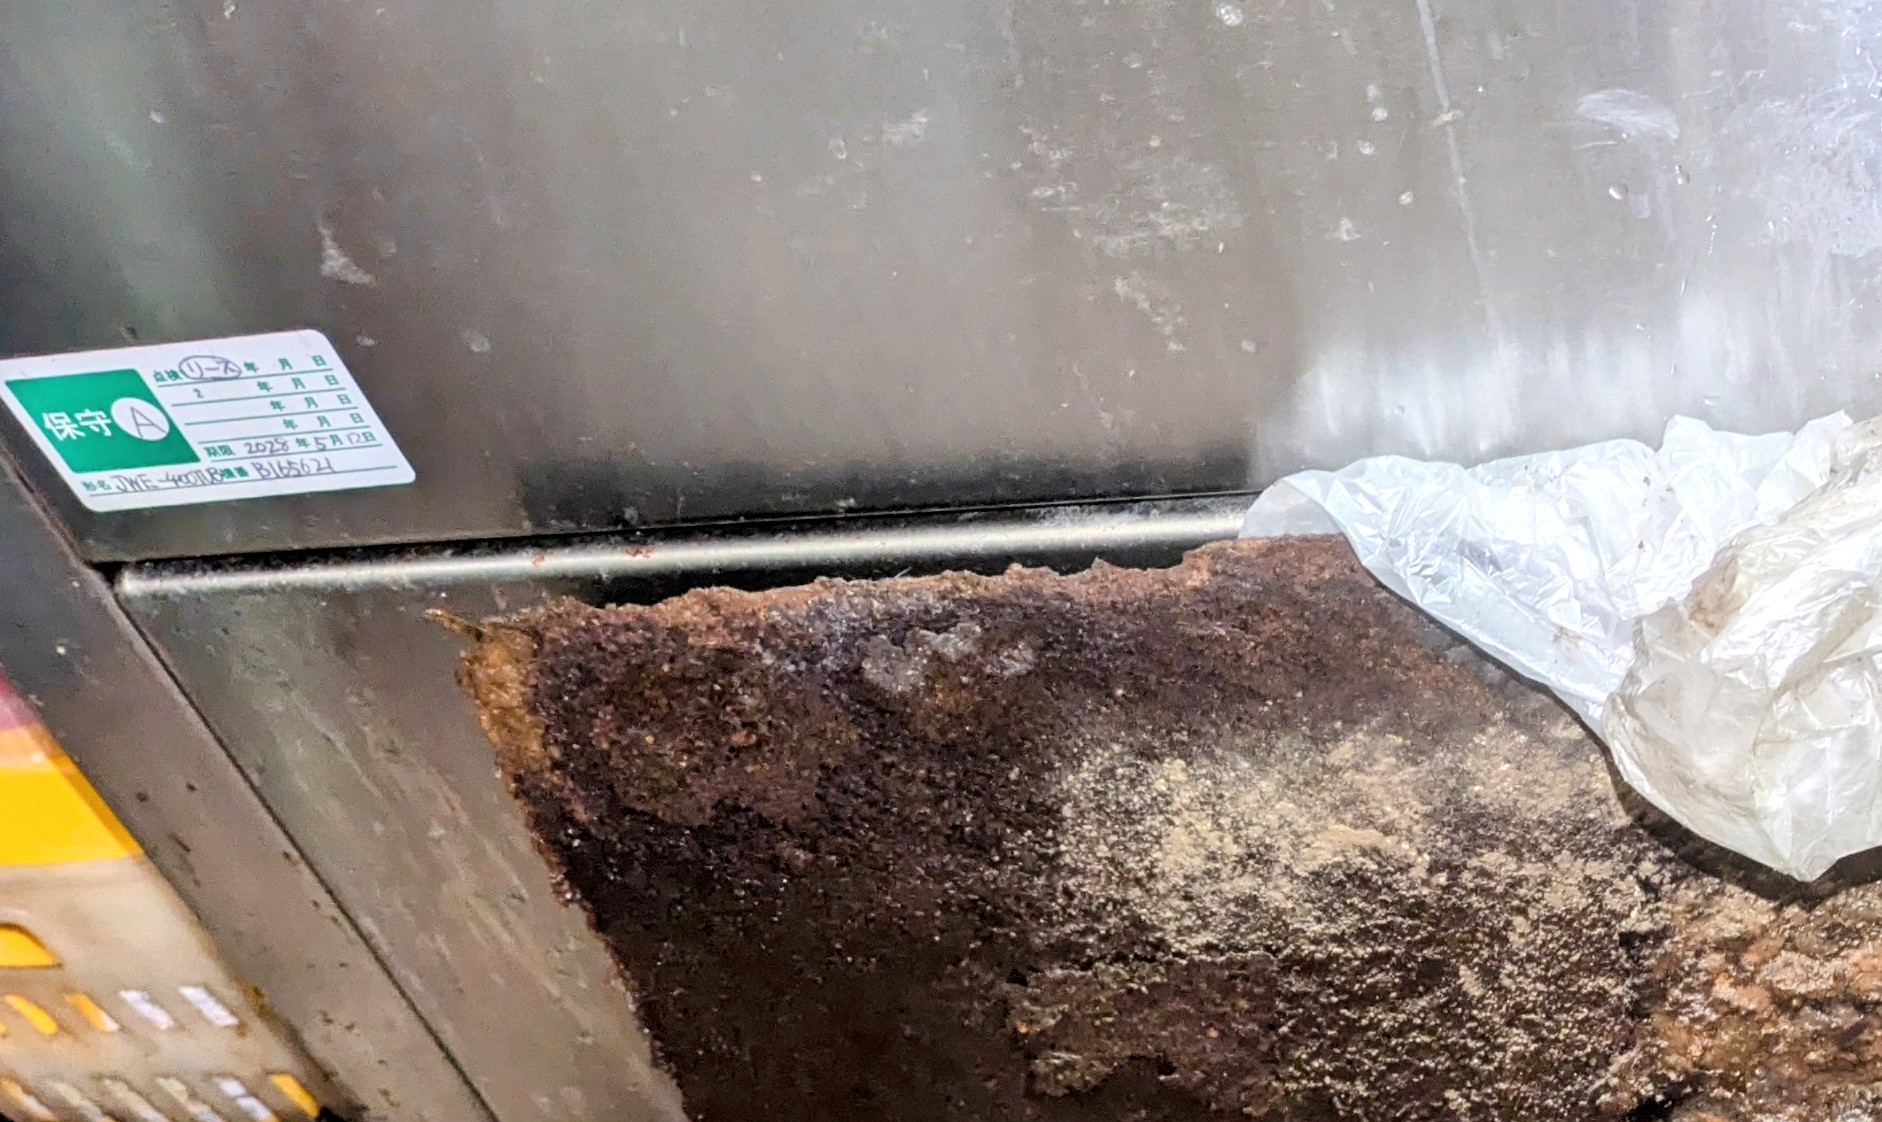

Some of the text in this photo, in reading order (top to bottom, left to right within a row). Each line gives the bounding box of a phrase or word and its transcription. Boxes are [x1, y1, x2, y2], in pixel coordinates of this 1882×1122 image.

[243, 360, 259, 373] 年
[278, 357, 293, 370] 月
[311, 354, 327, 367] 日
[257, 380, 273, 392] 年
[291, 377, 306, 390] 月
[325, 374, 339, 386] 日
[270, 394, 352, 411] 年 月 日
[42, 406, 167, 442] 保守 A
[283, 412, 364, 430] 年 月 日
